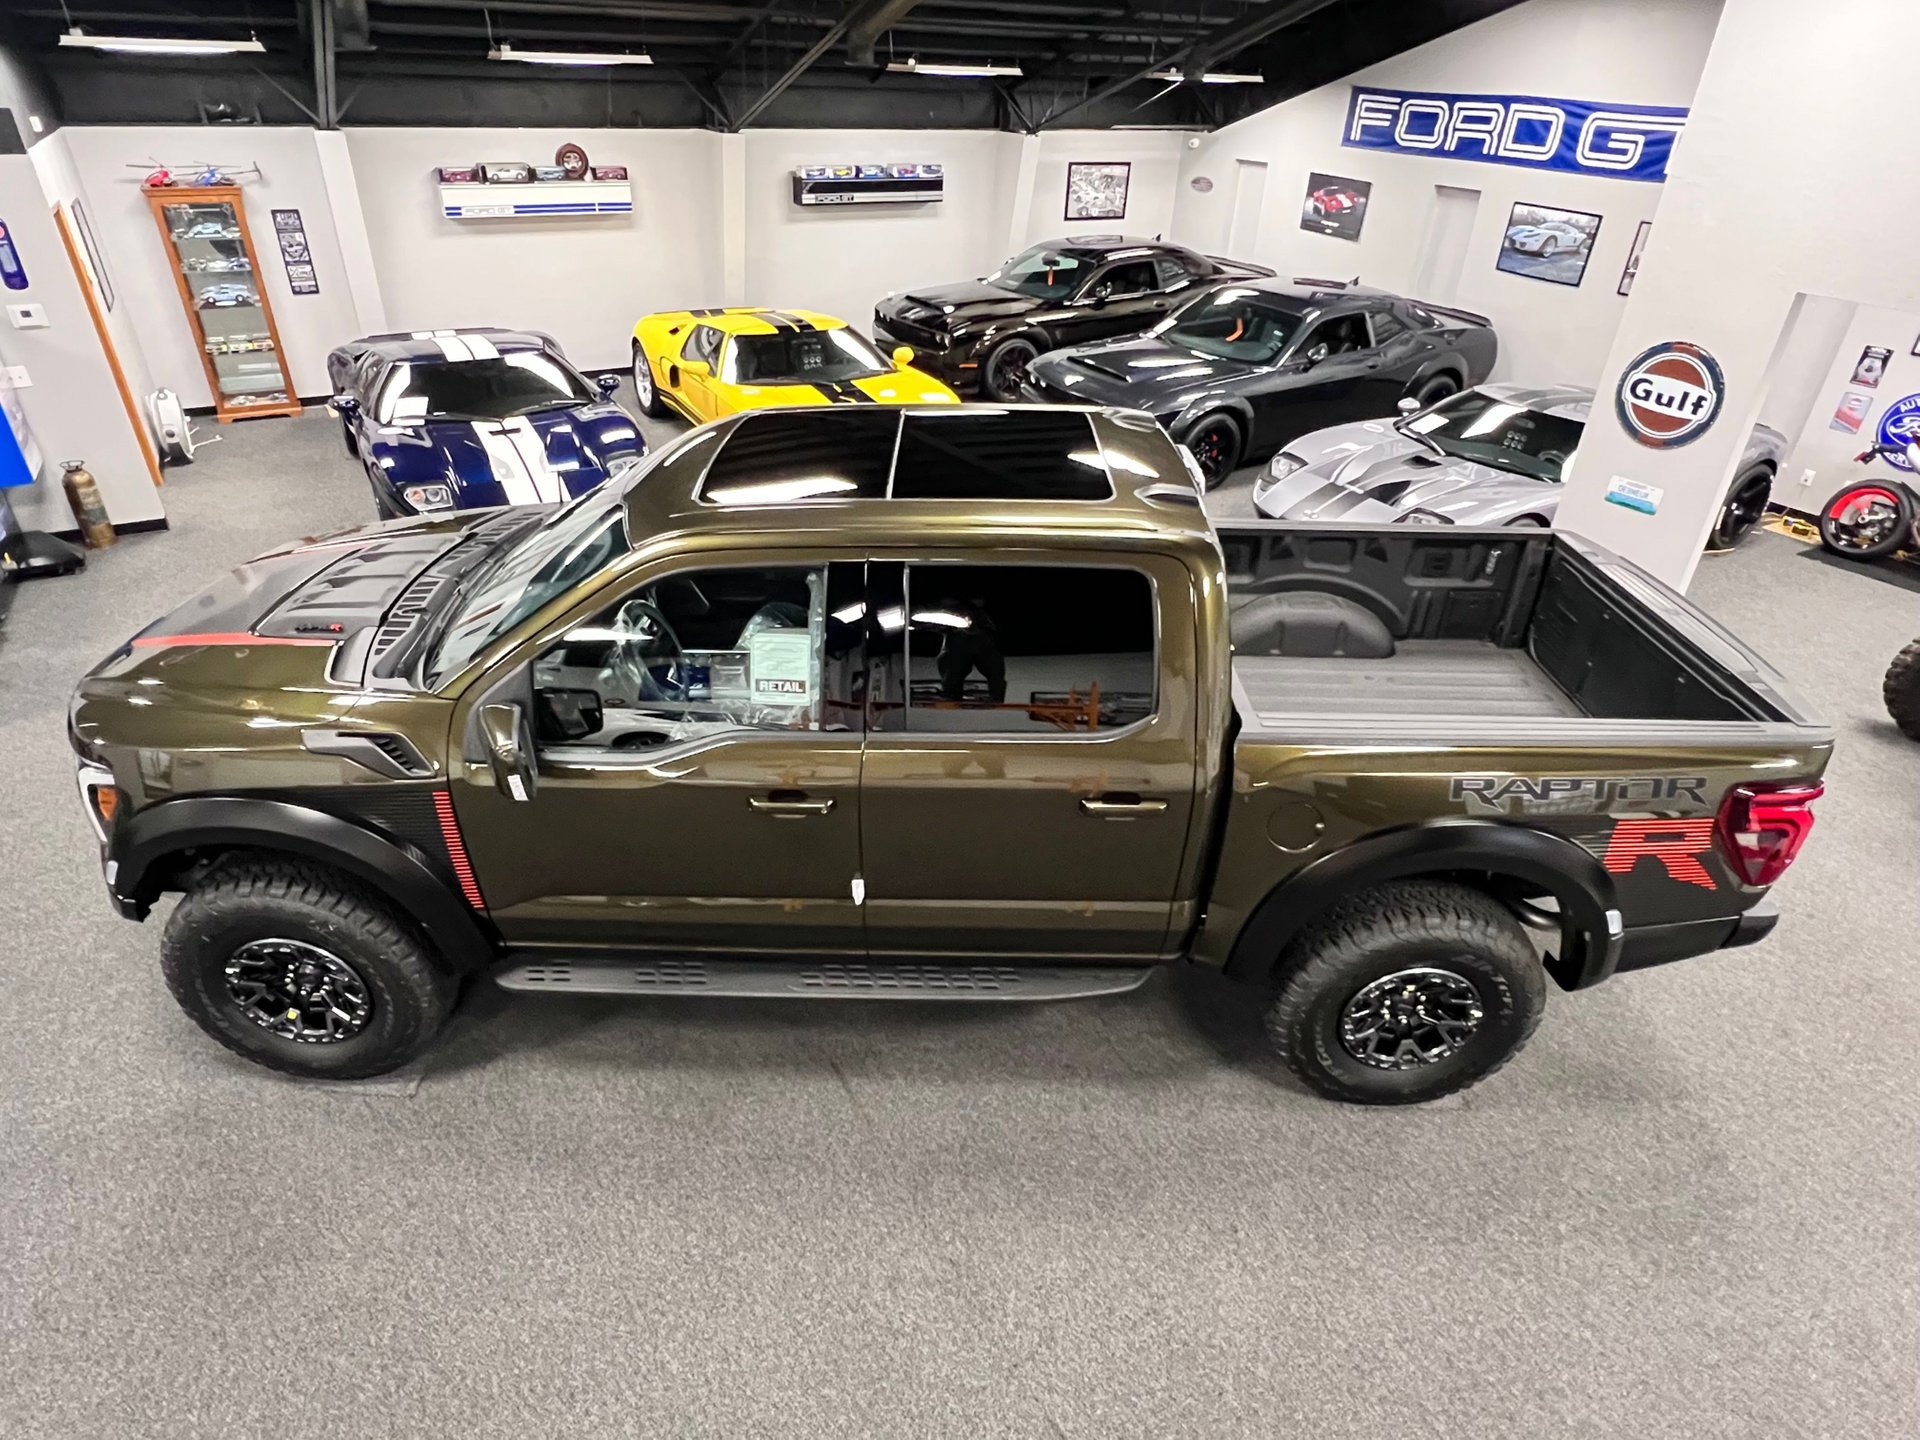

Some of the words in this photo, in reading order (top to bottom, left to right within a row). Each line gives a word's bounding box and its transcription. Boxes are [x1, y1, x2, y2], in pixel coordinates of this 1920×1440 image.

[1350, 93, 1568, 162] FORD
[1629, 377, 1708, 416] Gulf
[759, 680, 804, 693] RETAIL
[1450, 776, 1714, 813] RAPTOR
[1602, 817, 1718, 890] R
